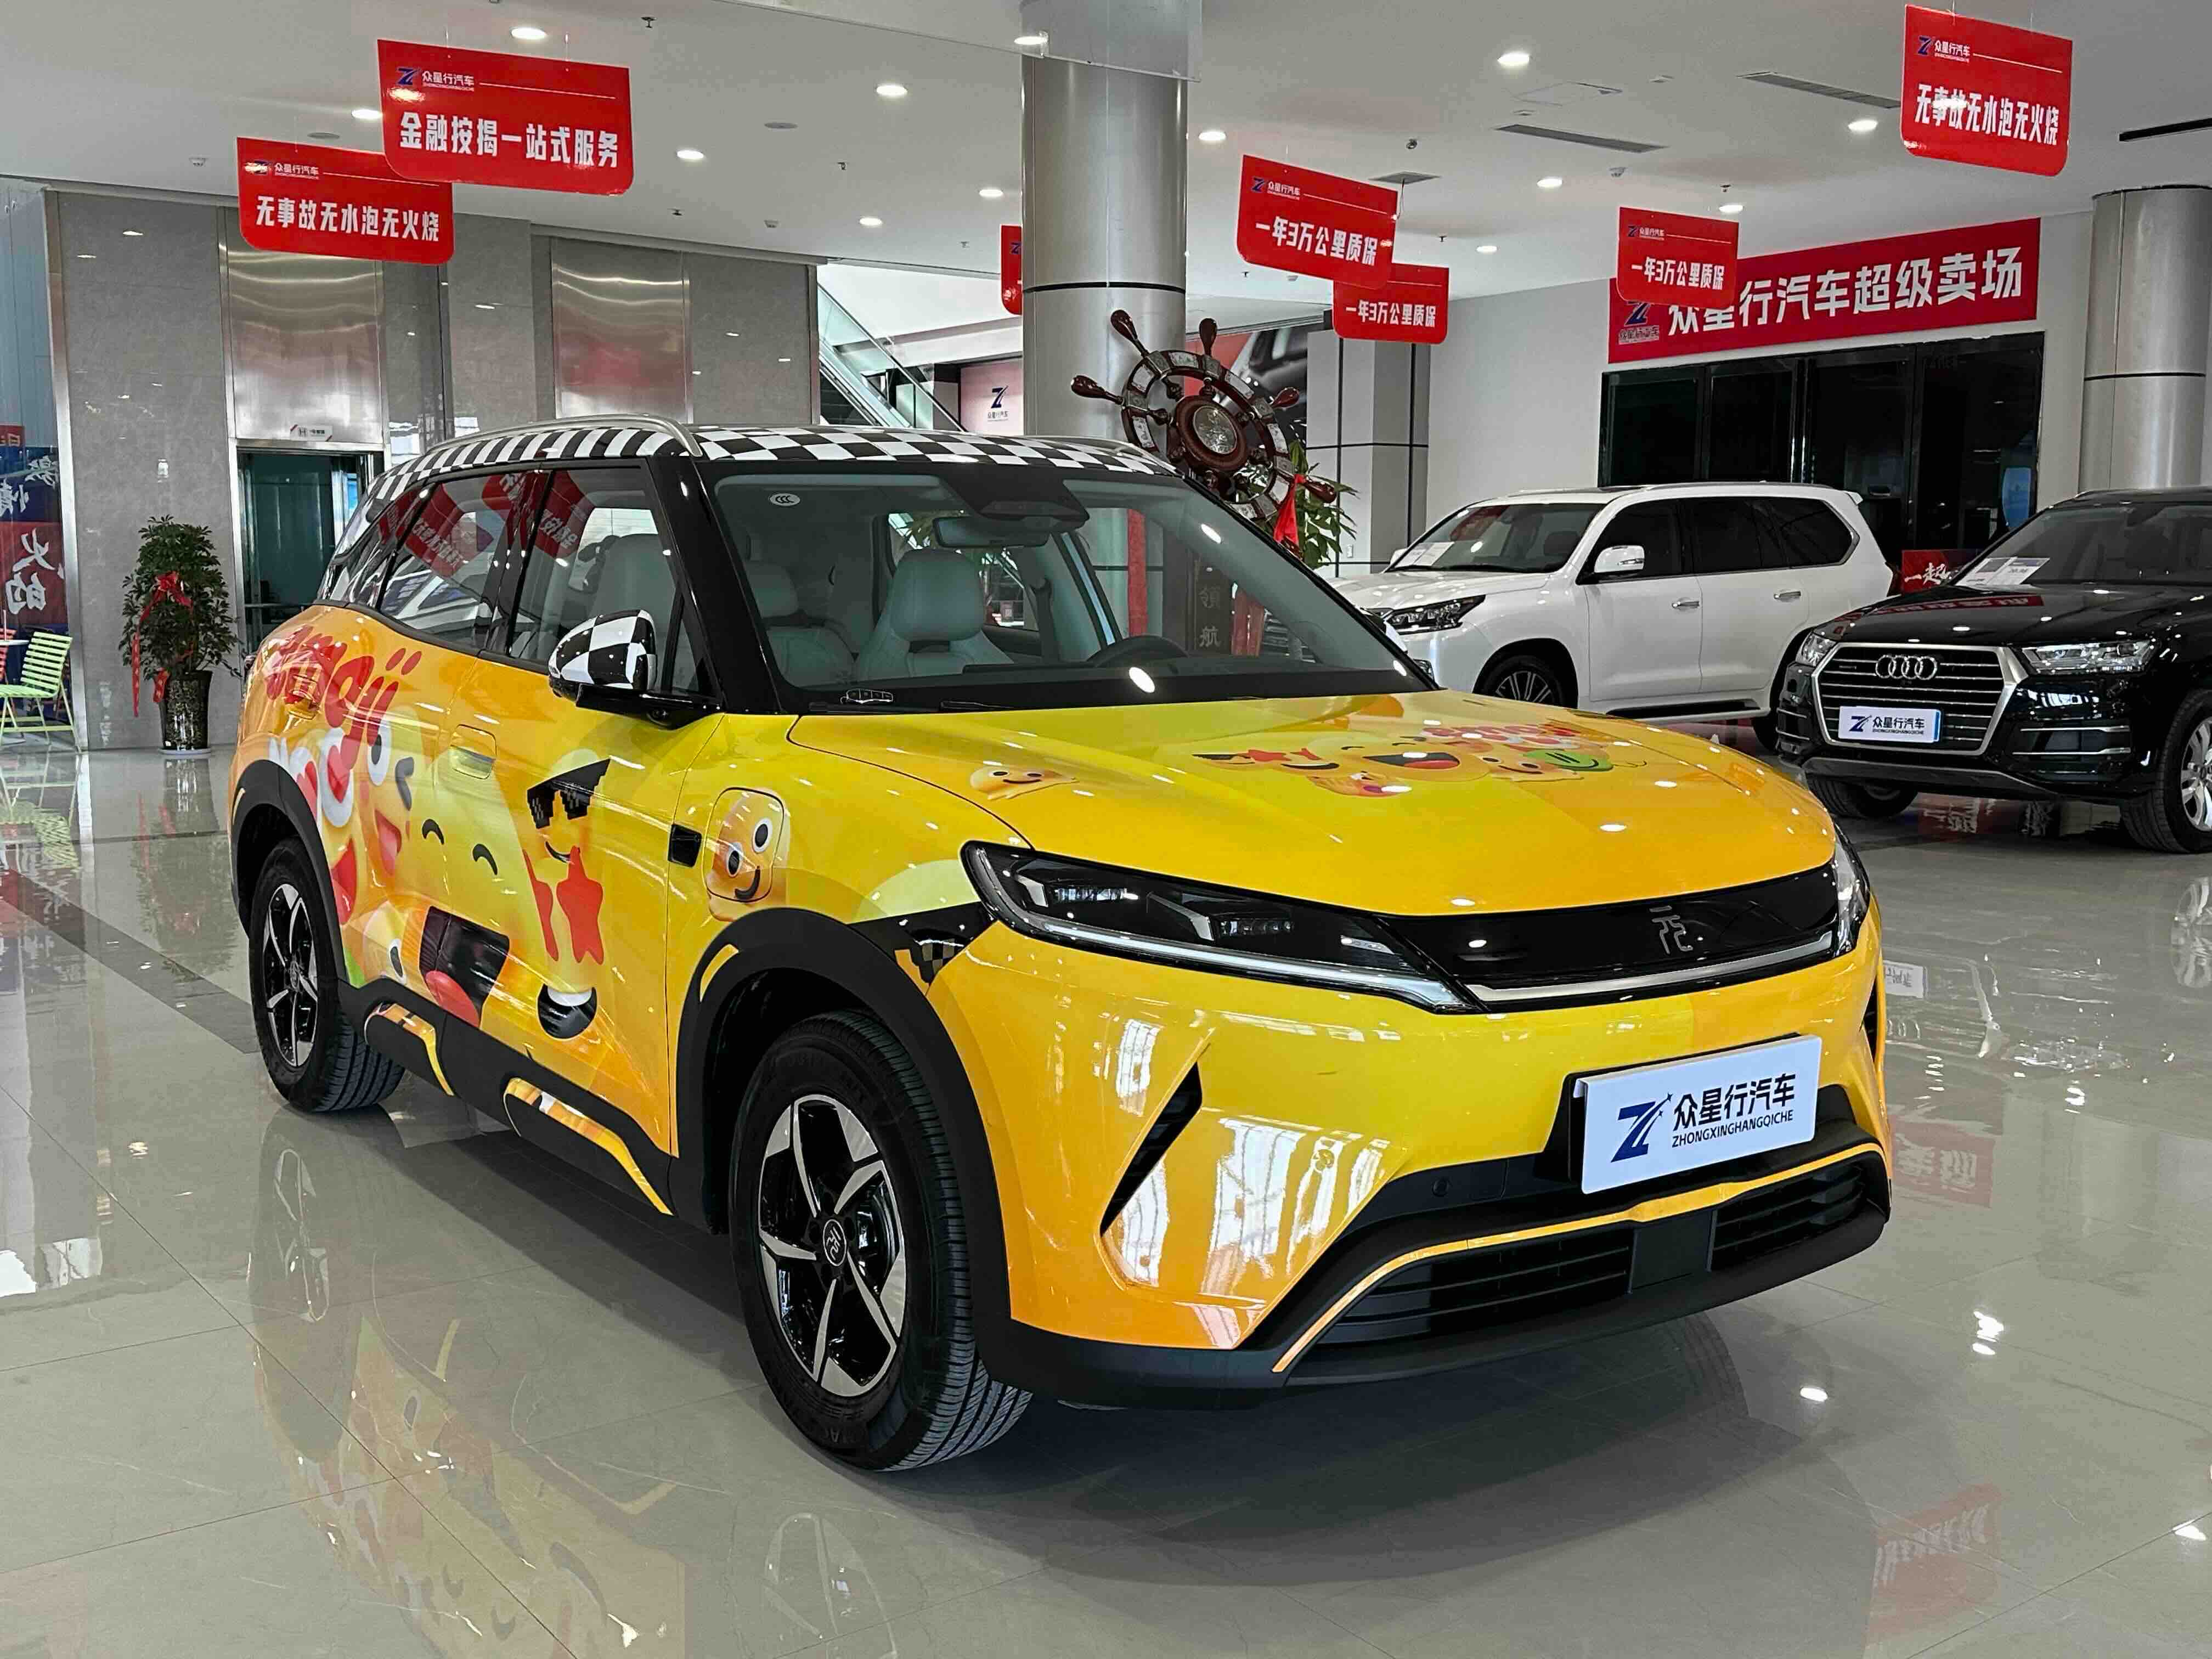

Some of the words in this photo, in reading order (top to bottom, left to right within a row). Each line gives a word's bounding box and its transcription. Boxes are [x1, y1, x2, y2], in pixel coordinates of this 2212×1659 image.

[1934, 40, 1971, 57] 众星行汽车
[422, 70, 475, 86] 众星行汽车
[1915, 83, 2060, 145] 无事故无水泡无火烧
[399, 111, 618, 168] 金融按揭一站式服务
[256, 195, 439, 242] 无事故无水泡无火烧
[1256, 216, 1378, 266] 一年3万公里质保
[1632, 256, 1725, 290] 一年3万公里质保
[1346, 300, 1436, 328] 一年3万公里质保
[1872, 716, 1925, 729] 众星行汽车
[1673, 1073, 1796, 1131] 众星行汽车
[1672, 1109, 1794, 1148] ZHONGXINGHANGQICHE
